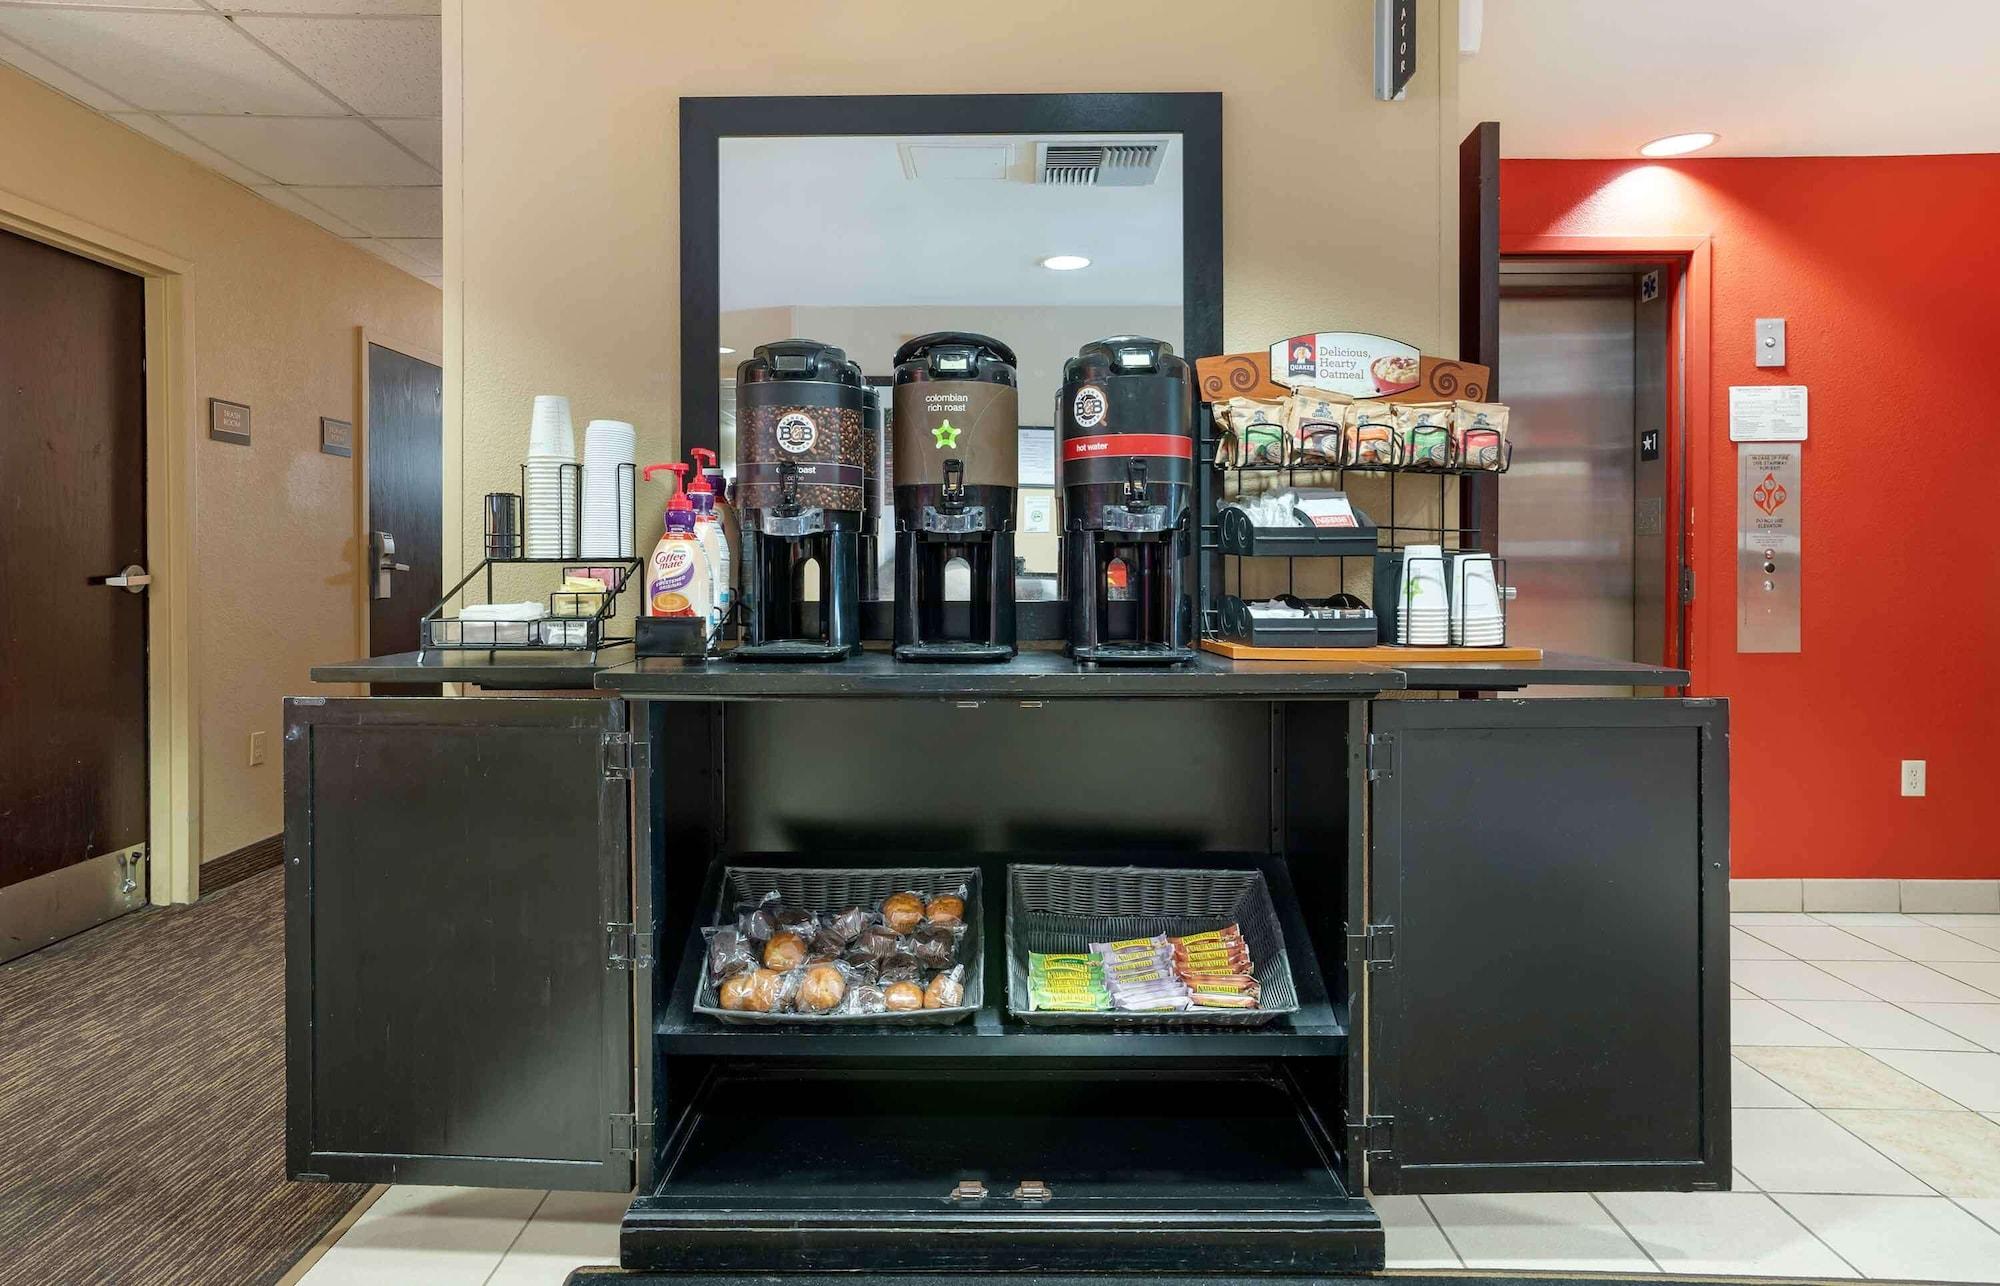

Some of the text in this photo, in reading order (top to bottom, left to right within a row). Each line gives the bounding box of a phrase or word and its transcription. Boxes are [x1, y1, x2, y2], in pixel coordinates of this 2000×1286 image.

[1320, 346, 1371, 358] Delicious,
[1320, 358, 1357, 370] Hearty
[1320, 369, 1364, 380] Oatmeal
[925, 393, 968, 402] colombian
[1076, 442, 1109, 452] hot water
[797, 466, 816, 474] oast
[655, 551, 686, 565] Coffee
[659, 561, 683, 570] mate
